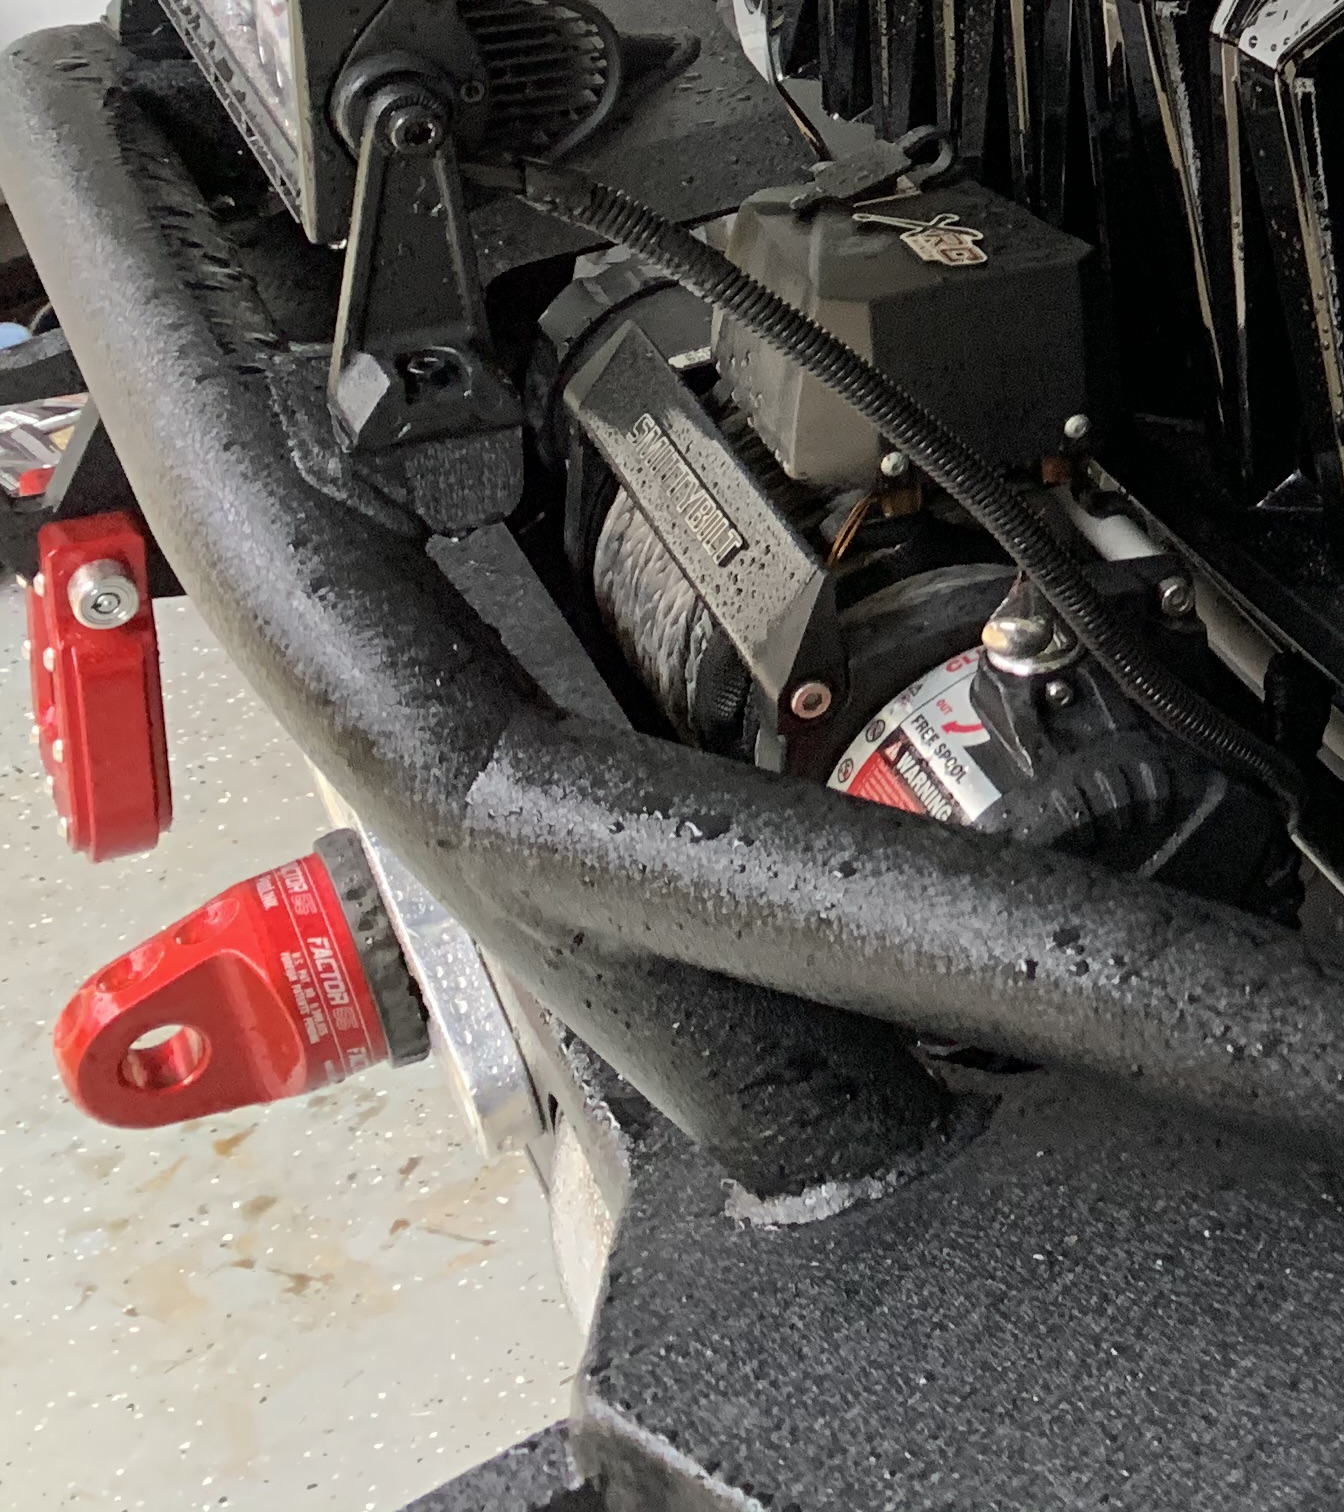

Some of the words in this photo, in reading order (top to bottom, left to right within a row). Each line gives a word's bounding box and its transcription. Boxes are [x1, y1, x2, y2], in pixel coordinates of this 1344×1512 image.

[626, 413, 745, 566] SMITTYBILT
[945, 648, 985, 673] CL
[936, 698, 953, 715] OUT
[911, 714, 939, 747] FREE
[934, 743, 968, 784] SPOOL
[896, 752, 952, 822] WARNING
[306, 936, 350, 1006] FACTOR
